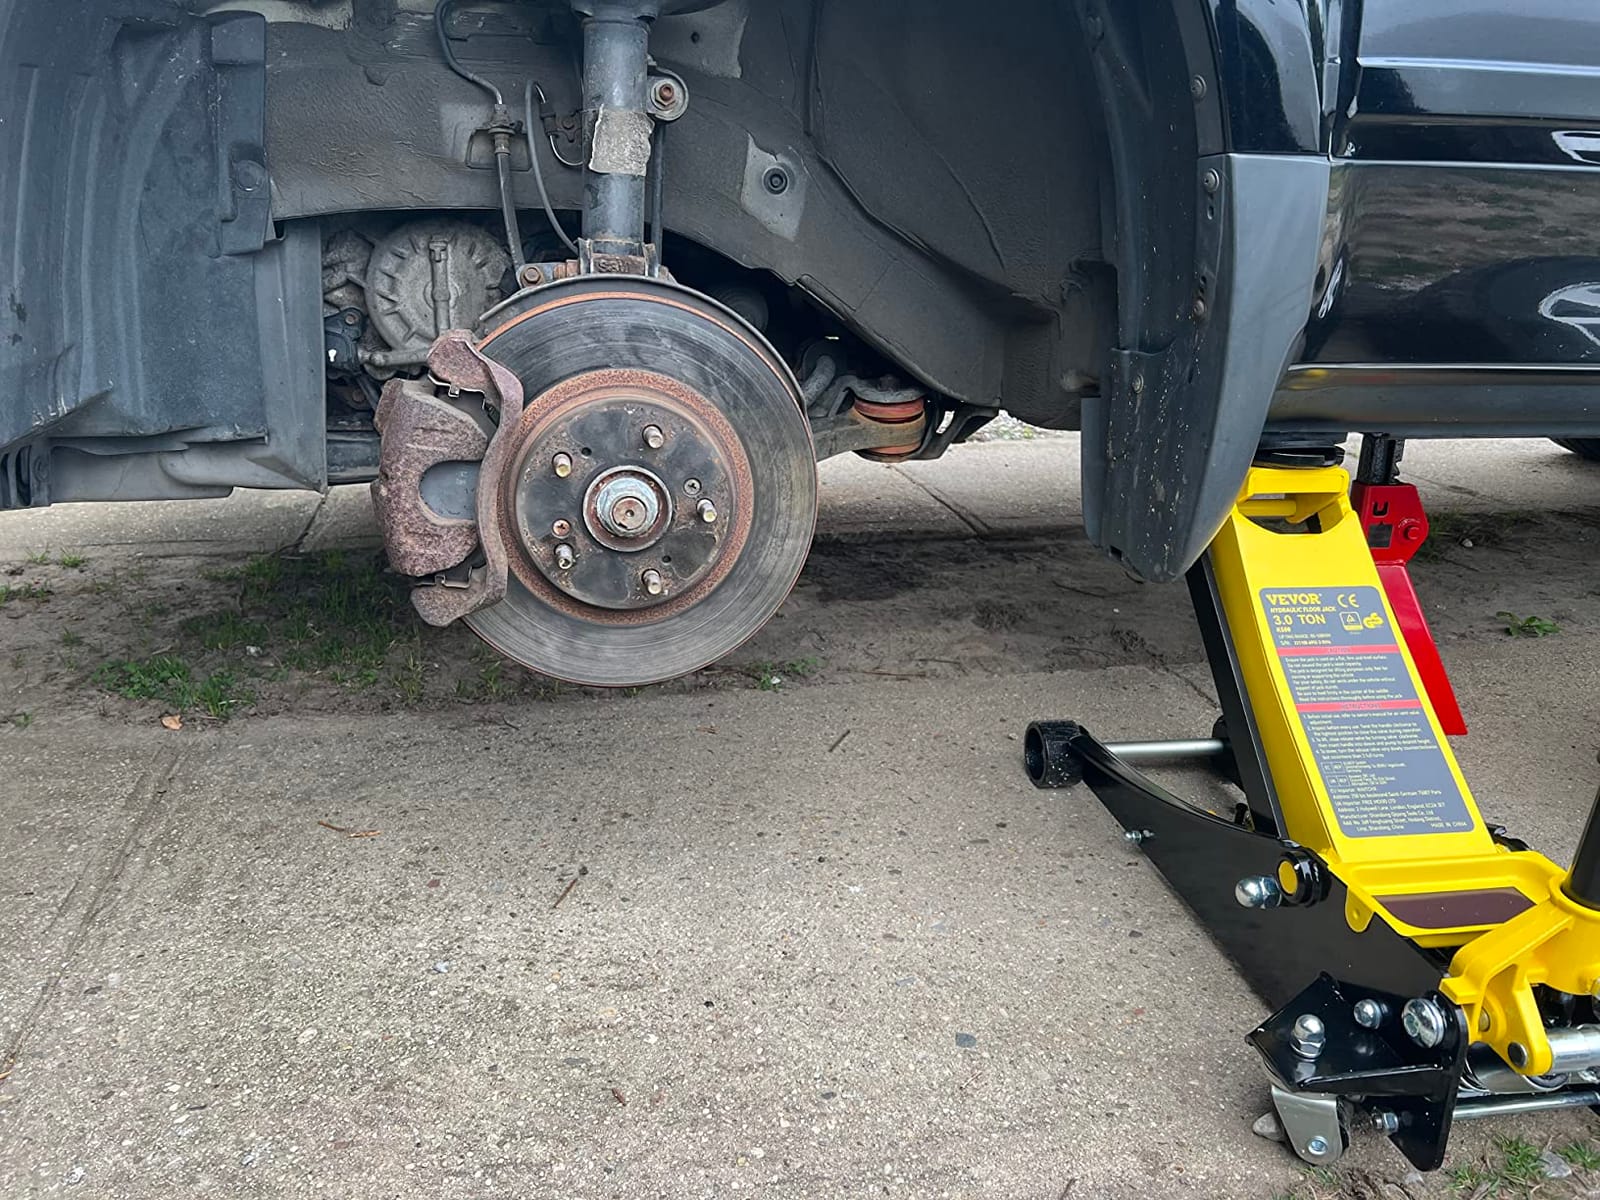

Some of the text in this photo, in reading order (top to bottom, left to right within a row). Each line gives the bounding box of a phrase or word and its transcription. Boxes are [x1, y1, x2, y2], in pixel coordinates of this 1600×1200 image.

[1265, 593, 1321, 605] VEVOR
[1273, 614, 1326, 625] 3.0 TON
